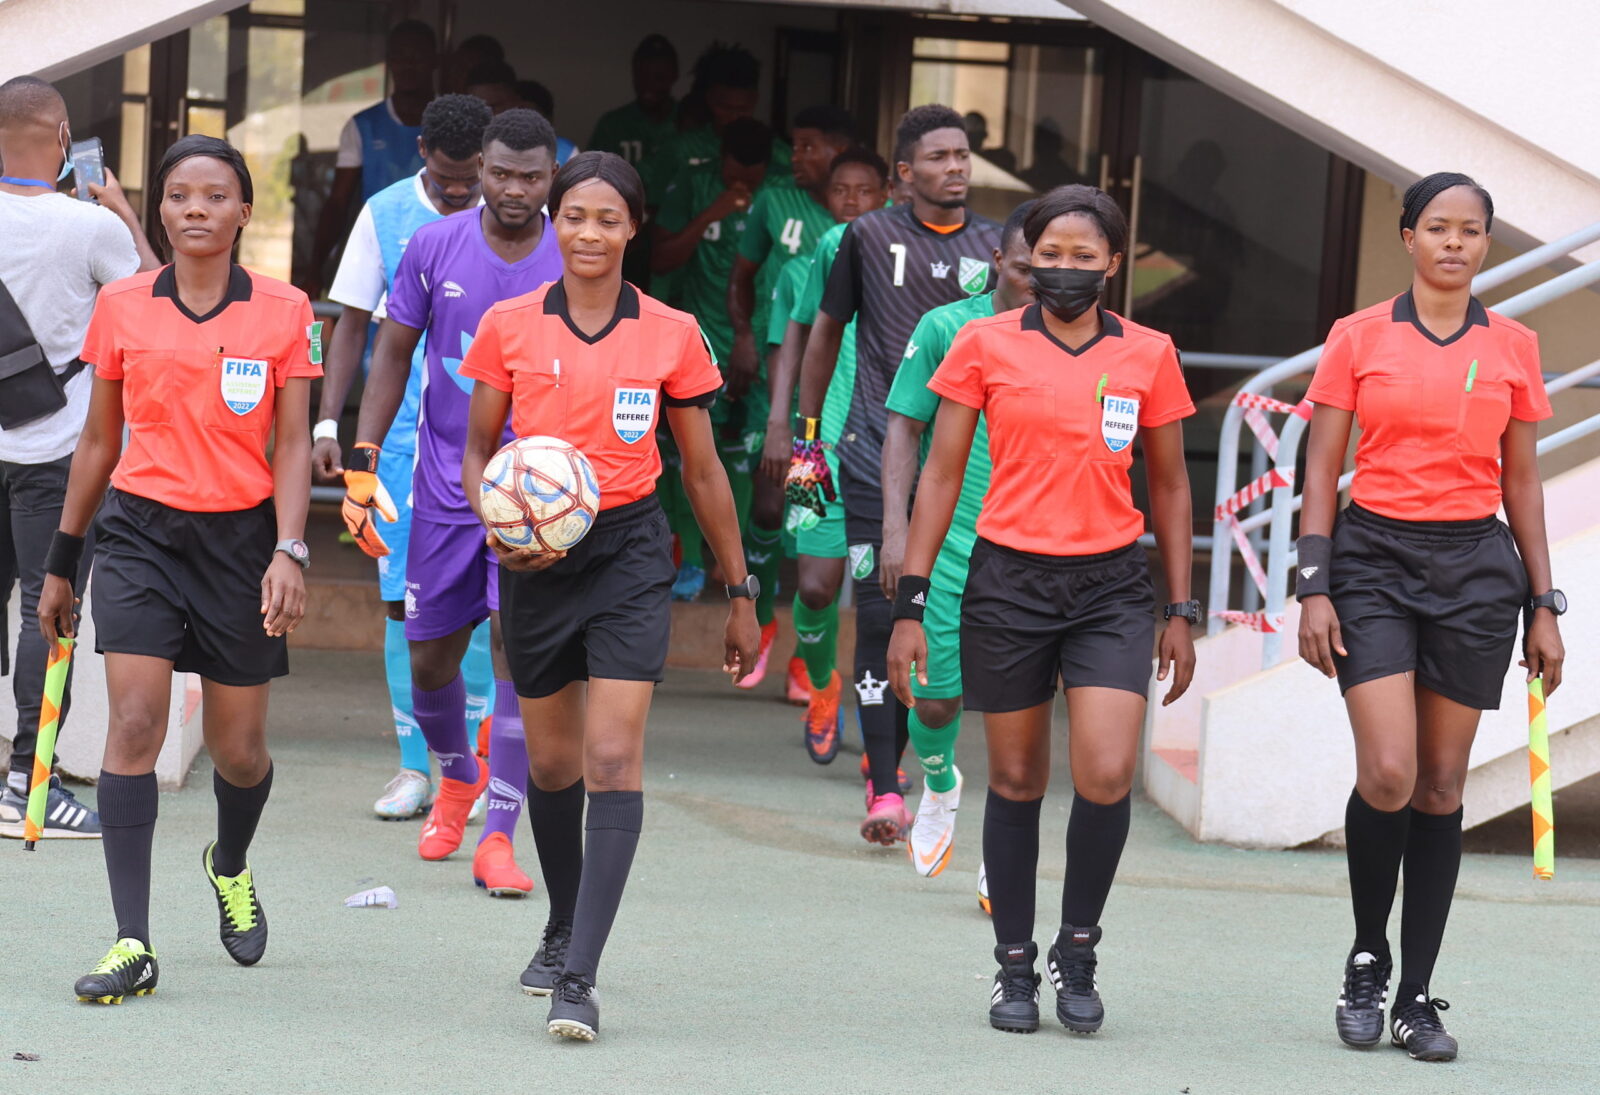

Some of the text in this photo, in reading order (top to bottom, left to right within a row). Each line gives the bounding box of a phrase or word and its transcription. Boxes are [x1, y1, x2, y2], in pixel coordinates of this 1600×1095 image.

[781, 218, 803, 254] 4
[890, 244, 906, 286] 1
[226, 361, 262, 376] FIFA
[233, 401, 250, 409] 2022
[618, 391, 651, 405] FIFA
[1107, 399, 1135, 415] FIFA
[616, 413, 650, 421] REFEREE
[1105, 421, 1134, 431] REFEREE
